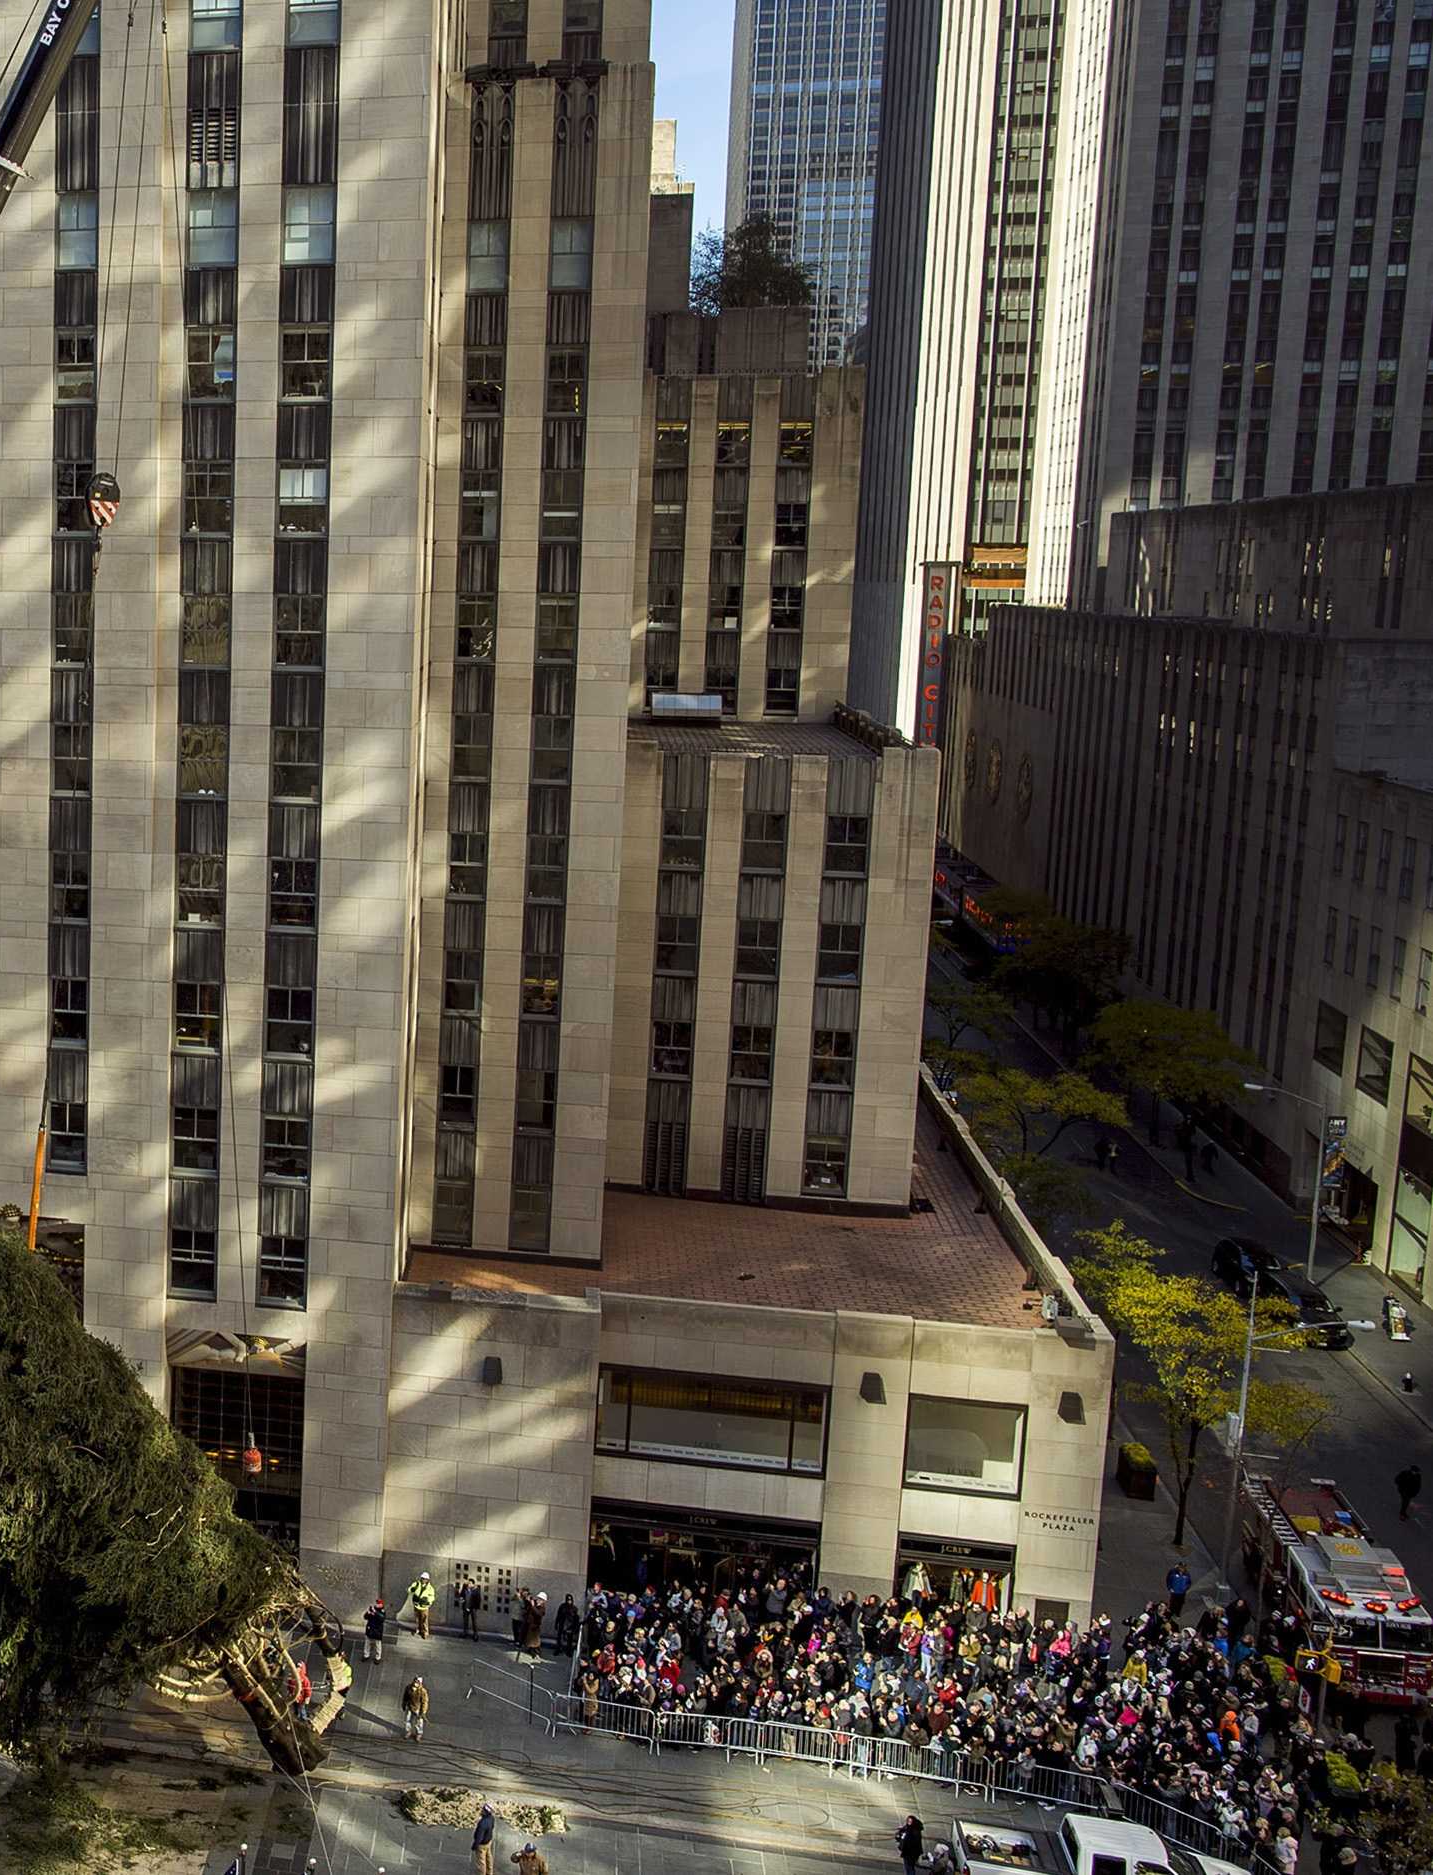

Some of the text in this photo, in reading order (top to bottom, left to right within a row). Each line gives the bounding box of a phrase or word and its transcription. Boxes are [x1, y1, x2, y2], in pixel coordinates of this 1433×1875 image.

[40, 12, 65, 46] BAY
[920, 575, 944, 747] RADIO CIT
[1024, 1511, 1095, 1525] ROCKEFELLER
[1042, 1522, 1076, 1532] PLAZA
